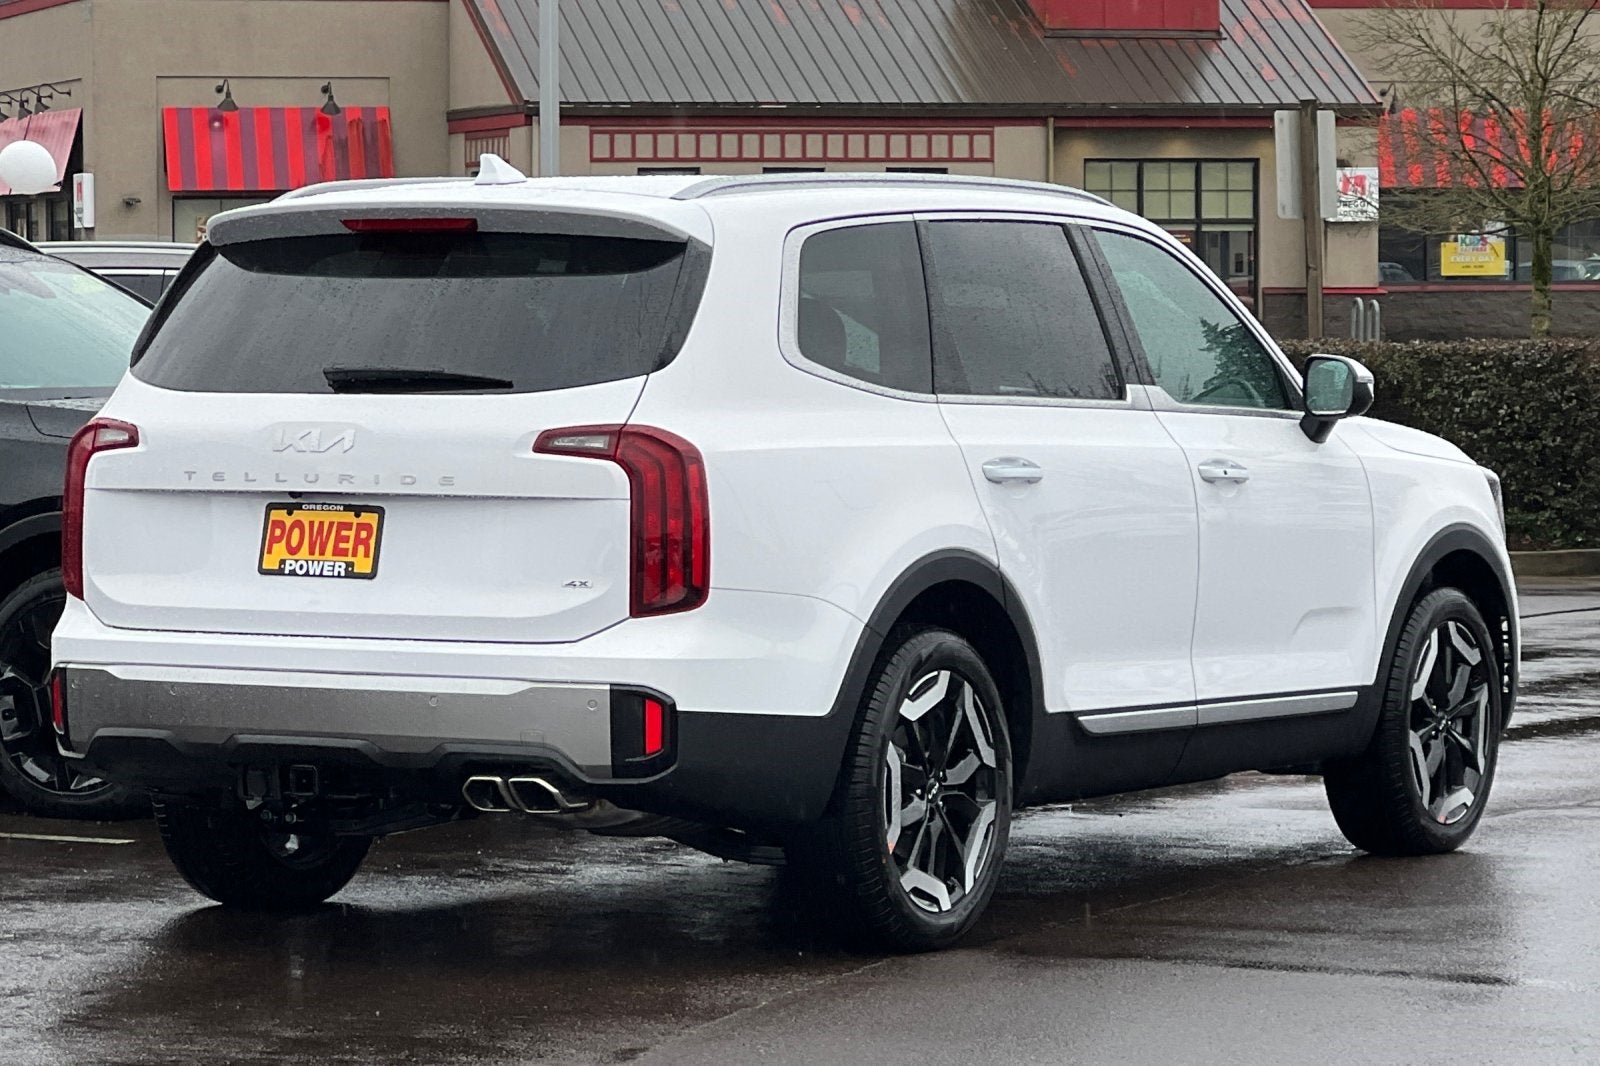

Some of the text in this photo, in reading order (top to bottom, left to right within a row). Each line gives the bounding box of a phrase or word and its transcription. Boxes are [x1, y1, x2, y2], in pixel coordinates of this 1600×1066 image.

[1460, 235, 1489, 247] KIDS
[273, 427, 356, 454] KIA
[184, 470, 456, 487] TELLURIDE
[302, 503, 345, 512] OREGON
[266, 519, 374, 559] POWER
[284, 559, 347, 577] POWER
